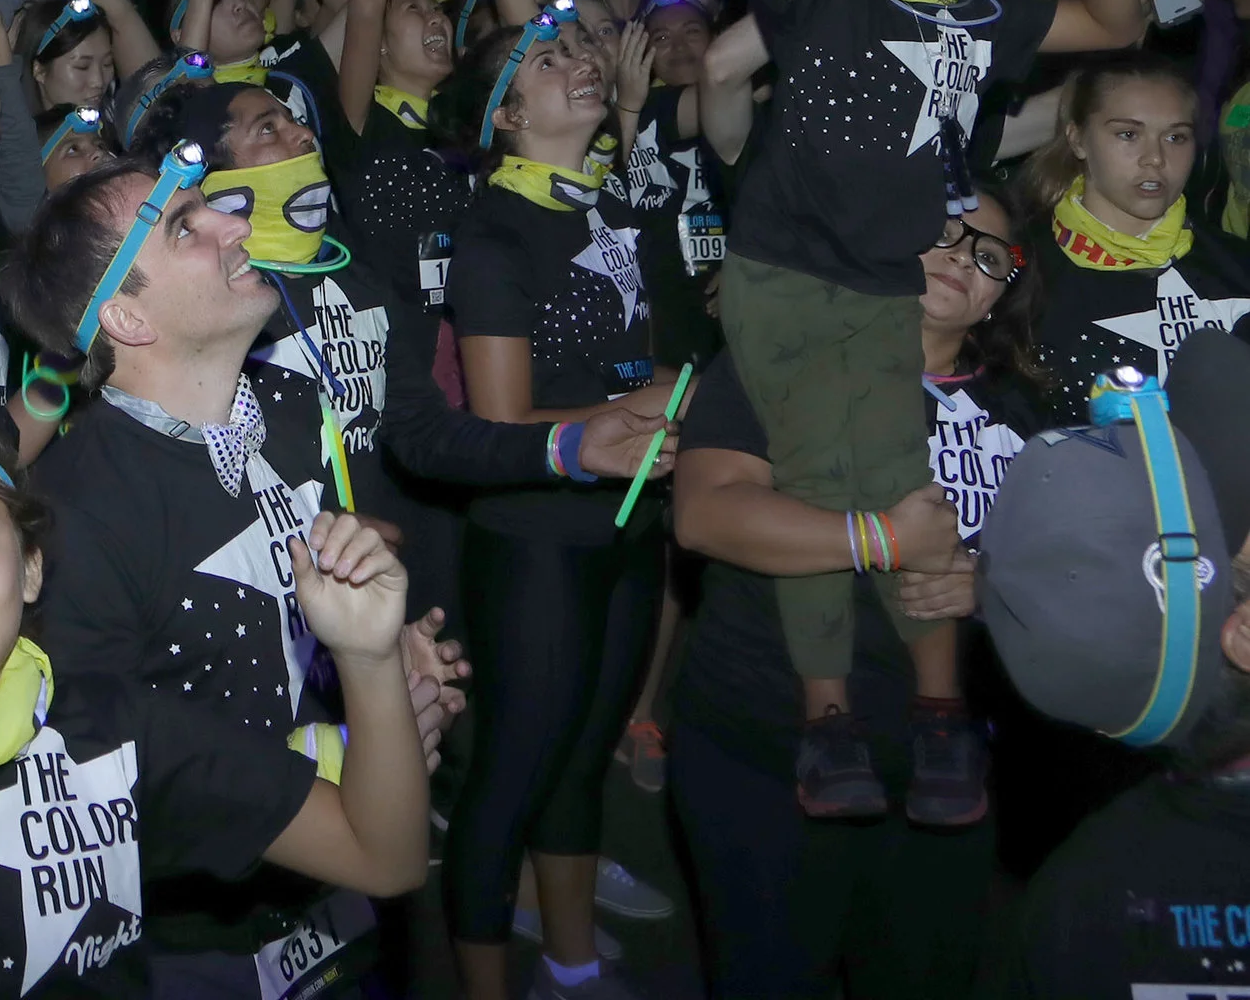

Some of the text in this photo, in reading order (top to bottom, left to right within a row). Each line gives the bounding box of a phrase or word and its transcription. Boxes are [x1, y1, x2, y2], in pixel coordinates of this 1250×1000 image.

[315, 305, 354, 339] THE
[1157, 295, 1198, 321] THE
[322, 340, 382, 376] COLOR
[253, 484, 304, 538] THE
[16, 753, 77, 806] THE
[20, 798, 141, 860] COLOR
[31, 856, 109, 917] RUN
[65, 915, 142, 976] Night
[1170, 904, 1223, 949] THE
